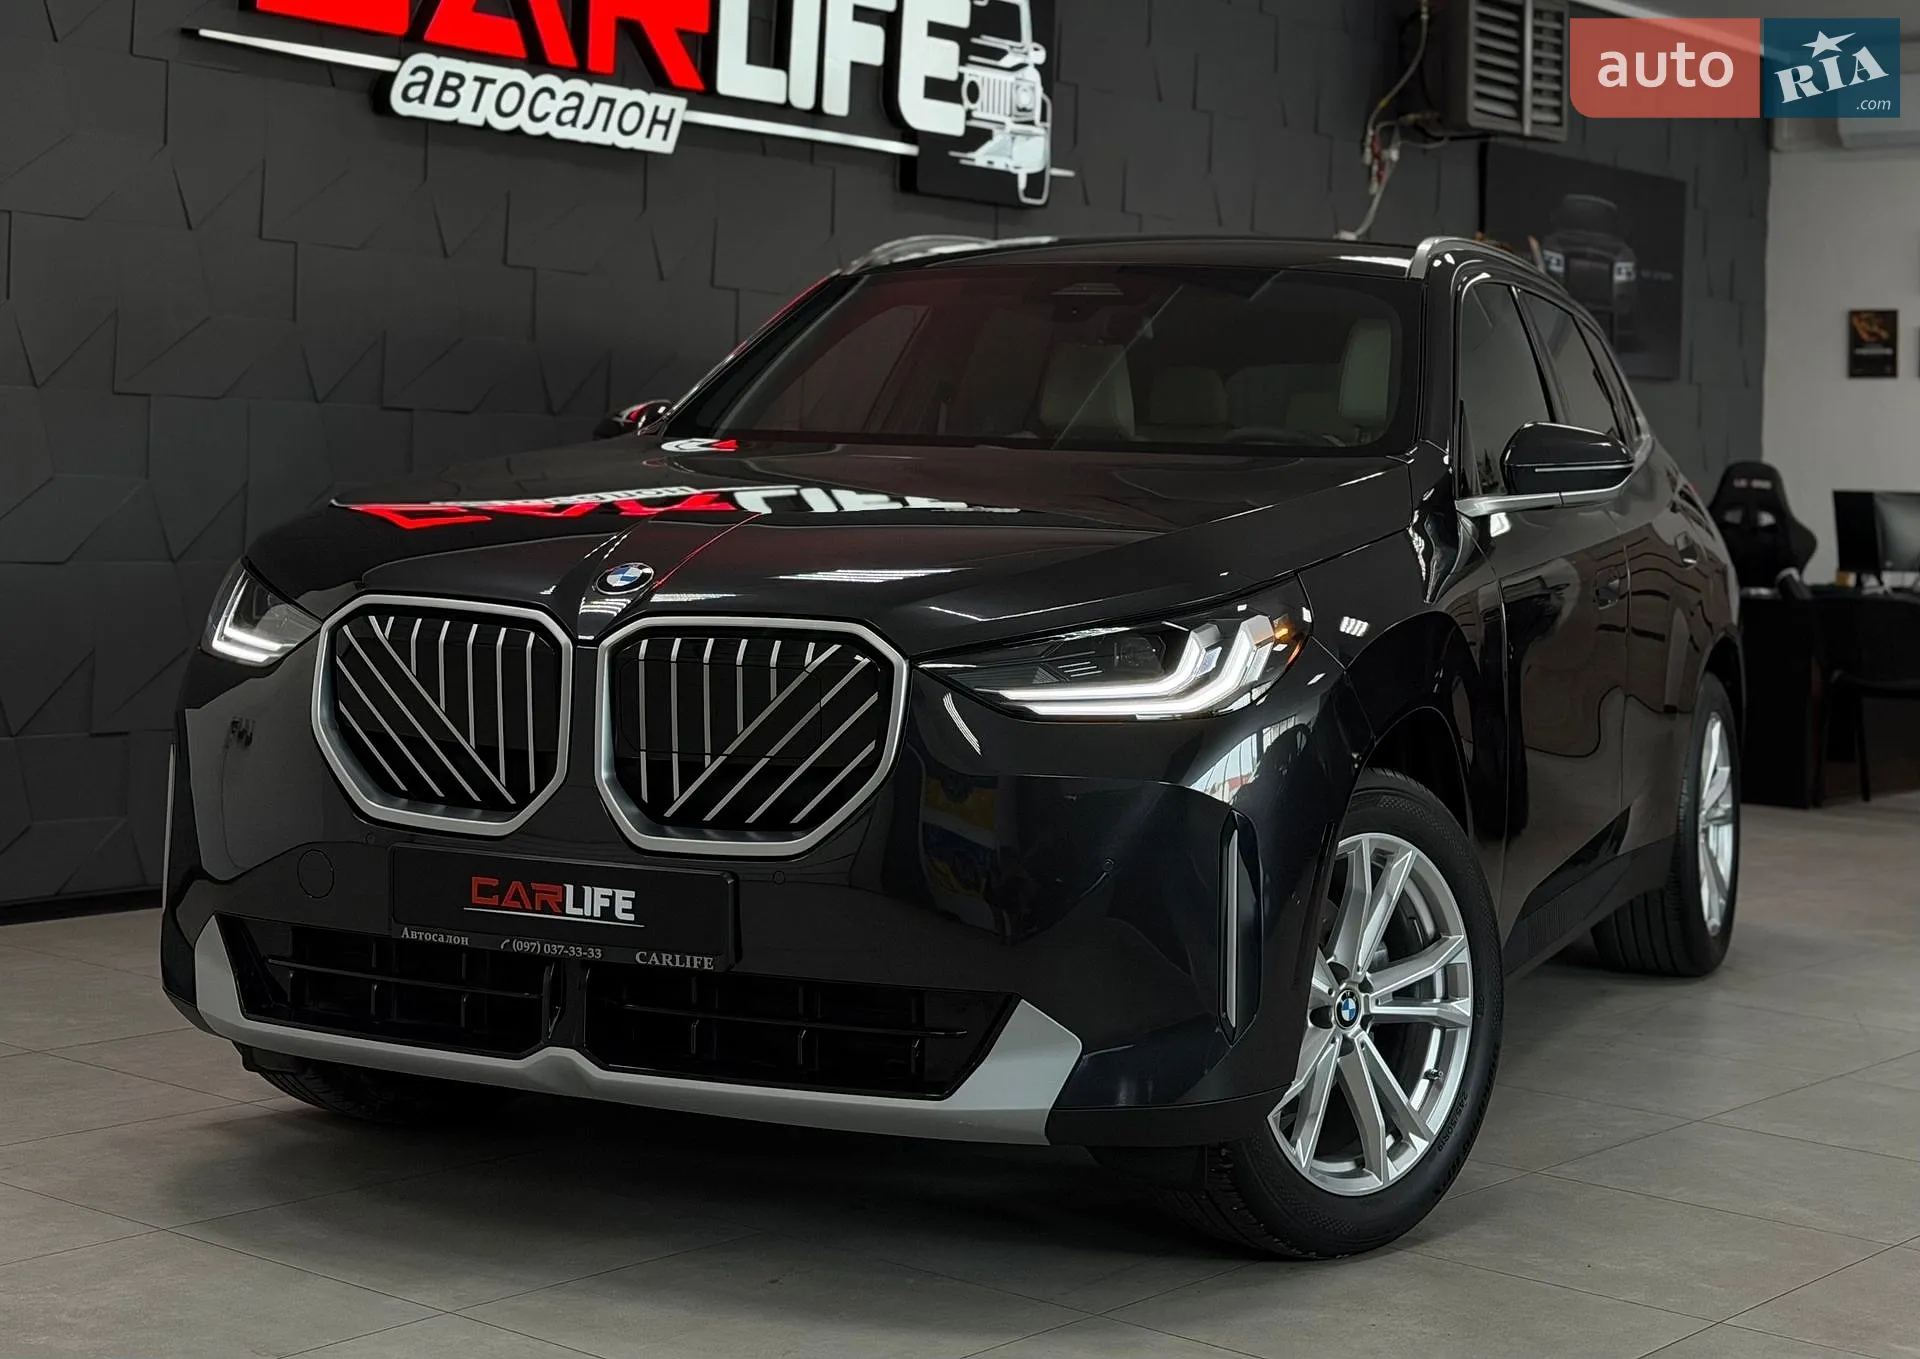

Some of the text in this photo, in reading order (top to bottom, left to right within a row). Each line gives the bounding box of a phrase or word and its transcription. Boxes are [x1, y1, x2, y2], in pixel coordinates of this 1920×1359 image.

[401, 64, 677, 142] автосалон
[471, 876, 635, 921] CARLIFE
[401, 927, 469, 945] Автосалон
[512, 939, 602, 960] (097) 037-33-33
[635, 951, 714, 970] CARLIFE
